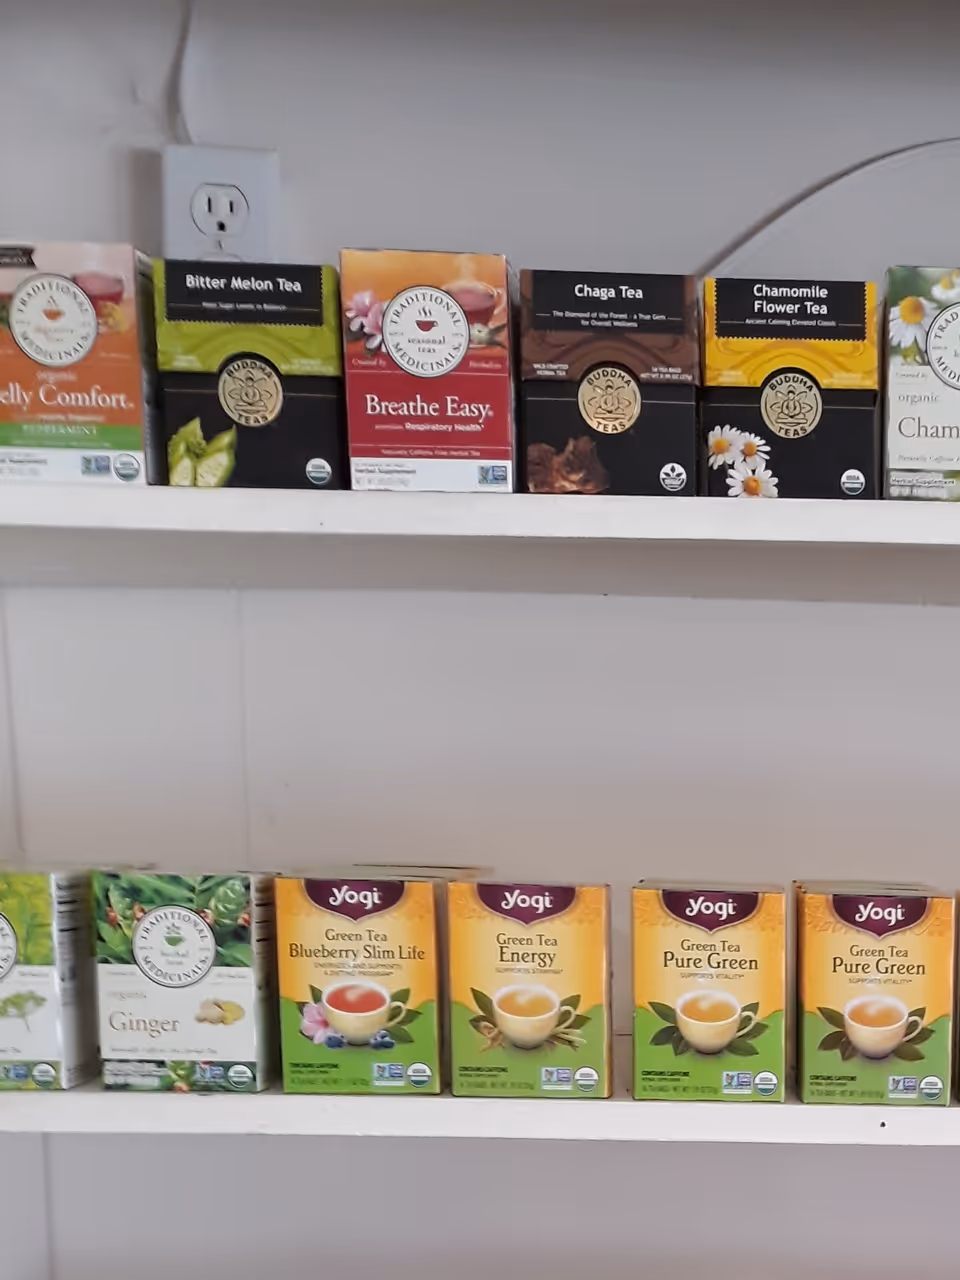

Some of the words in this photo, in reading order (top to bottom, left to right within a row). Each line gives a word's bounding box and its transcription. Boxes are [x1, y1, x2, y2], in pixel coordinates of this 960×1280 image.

[186, 274, 226, 289] Bitter
[231, 276, 273, 291] Melon
[277, 278, 302, 292] Tea
[574, 284, 616, 300] Chaga
[619, 286, 643, 299] Tea
[753, 284, 828, 298] Chamomile
[390, 292, 463, 325] TRADITIONAL
[754, 300, 800, 314] Flower
[804, 302, 828, 315] Tea
[391, 343, 463, 372] MEDICINALS
[586, 369, 632, 387] BUDDHA
[769, 375, 814, 393] BUDDHA
[0, 382, 33, 410] elly
[898, 392, 940, 405] organic
[365, 394, 439, 416] Breathe
[446, 396, 490, 423] Easy
[237, 413, 268, 425] TEAS
[596, 421, 626, 432] TEAS
[777, 426, 808, 437] TEAS
[325, 929, 362, 942] Green
[366, 930, 388, 942] Tea
[497, 933, 533, 946] Green
[536, 934, 558, 946] Tea
[289, 943, 358, 961] Blueberry
[363, 945, 394, 960] Slim
[399, 945, 425, 960] Life
[680, 939, 717, 952] Green
[720, 941, 741, 952] Tea
[850, 945, 885, 957] Green
[888, 946, 908, 958] Tea
[499, 946, 556, 967] Energy
[663, 951, 702, 968] Pure
[707, 953, 758, 970] Green
[832, 956, 871, 974] Pure
[876, 958, 925, 975] Green
[109, 1011, 179, 1038] Ginger
